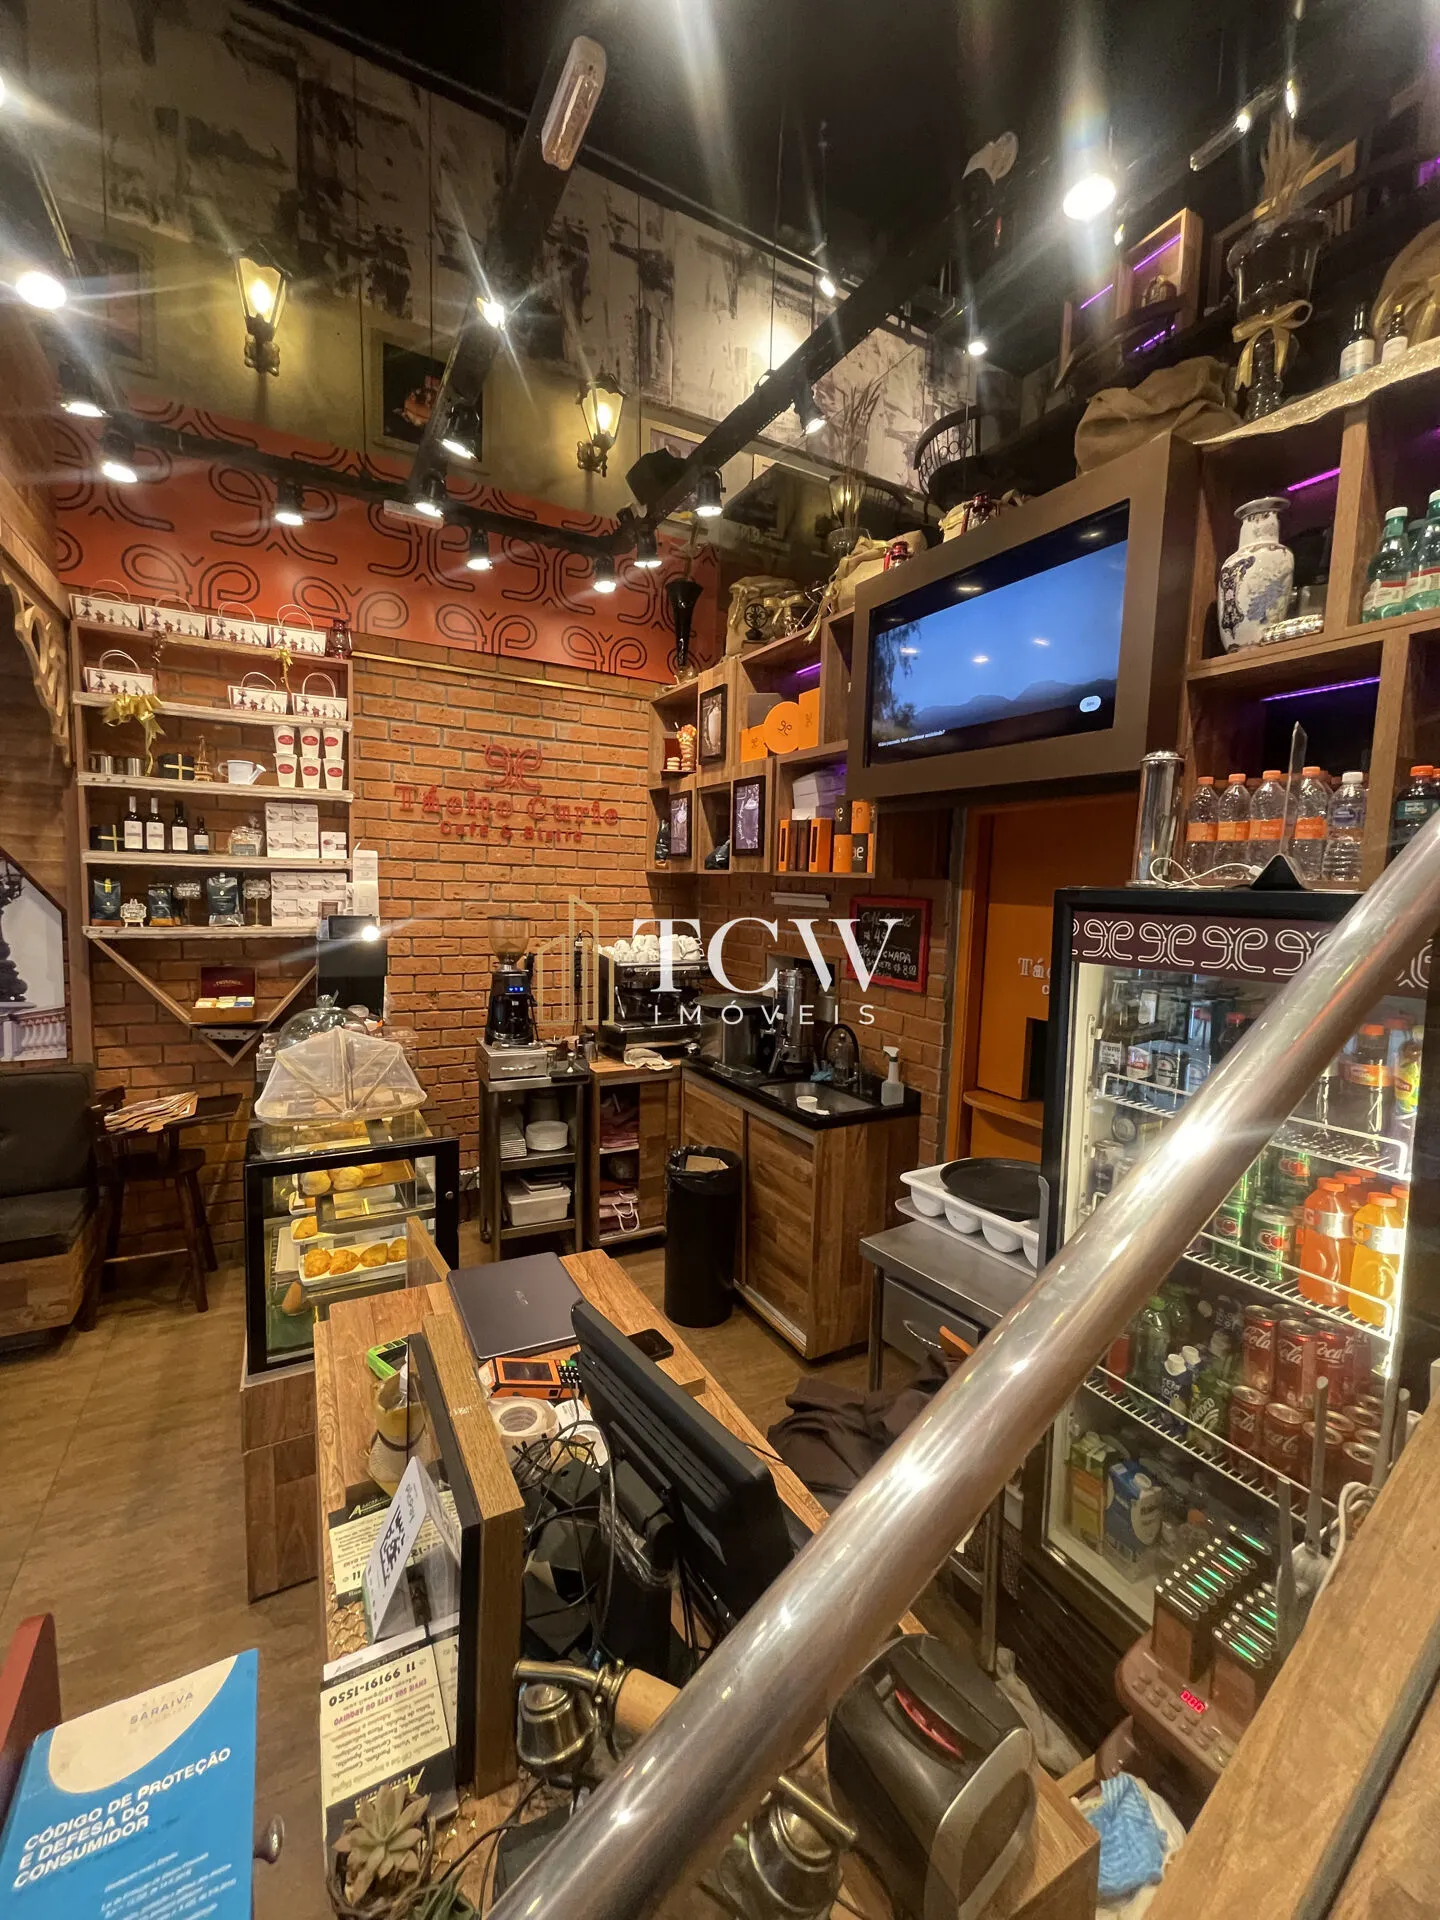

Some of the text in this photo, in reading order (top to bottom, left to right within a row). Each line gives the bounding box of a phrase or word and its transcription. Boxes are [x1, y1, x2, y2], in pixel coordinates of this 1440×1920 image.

[527, 796, 618, 826] Curie
[406, 1661, 416, 1673] 11
[329, 1667, 402, 1707] 99191-1550
[377, 1692, 394, 1706] ARTE
[130, 1692, 194, 1725] SARAIVA
[333, 1707, 365, 1727] ARQUIVO
[24, 1747, 232, 1851] CÓDIGO DE PROTEÇÃO
[12, 1815, 150, 1890] CONSUMIDOR
[18, 1801, 150, 1871] E DEFESA DO
